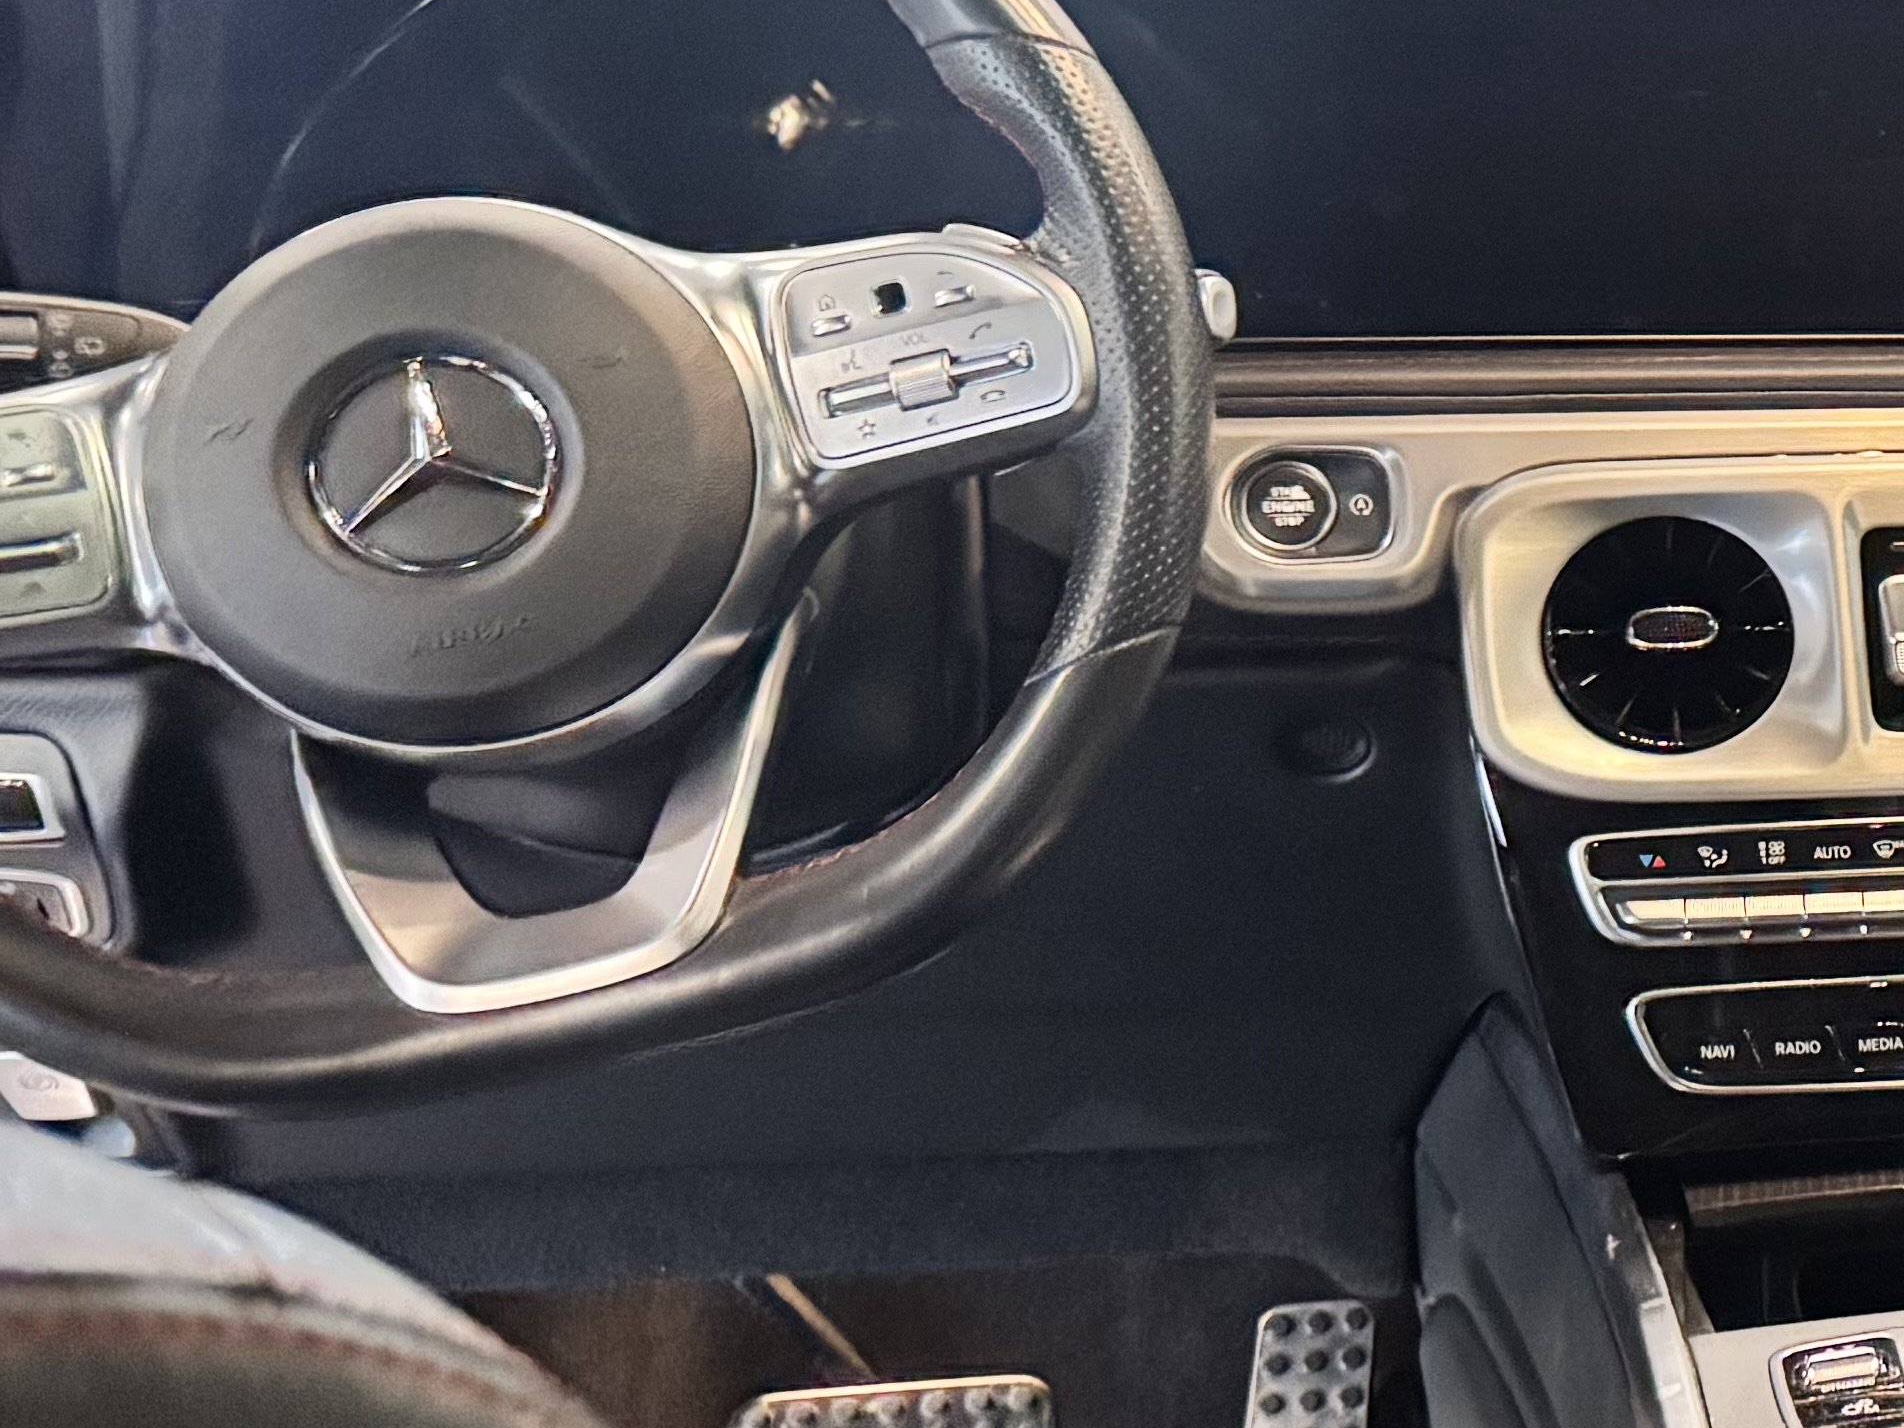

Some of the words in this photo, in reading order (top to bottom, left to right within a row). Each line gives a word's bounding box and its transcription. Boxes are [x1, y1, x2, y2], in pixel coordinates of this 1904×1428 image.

[1262, 500, 1315, 513] ENGINE
[1813, 845, 1852, 859] AUTO
[1768, 855, 1786, 865] OFF
[1775, 1040, 1822, 1056] RADIO
[1858, 1036, 1904, 1052] MEDIA
[1700, 1044, 1735, 1060] NAVI
